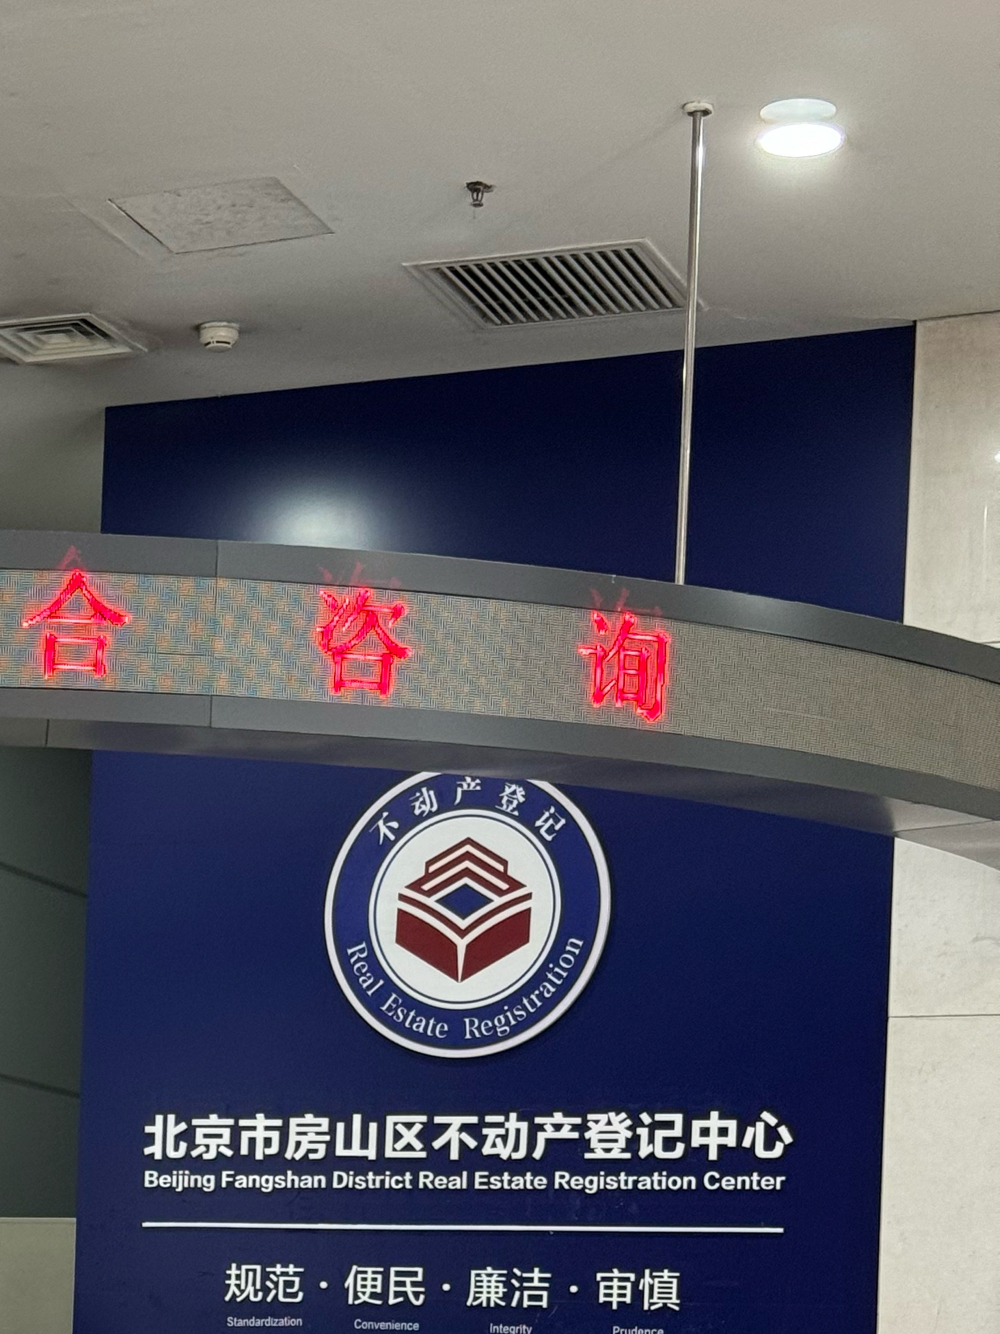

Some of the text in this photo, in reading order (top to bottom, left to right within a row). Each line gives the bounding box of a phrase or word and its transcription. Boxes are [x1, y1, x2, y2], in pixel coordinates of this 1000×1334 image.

[369, 776, 567, 845] 不动产登记
[347, 937, 584, 1039] Real Estate Registration
[143, 1111, 793, 1160] 北京市房山区不动产登记中心
[144, 1170, 786, 1194] Beijing Fangshan District Real Estate Registration Center
[226, 1316, 303, 1327] Standardization
[354, 1319, 420, 1331] Convenience
